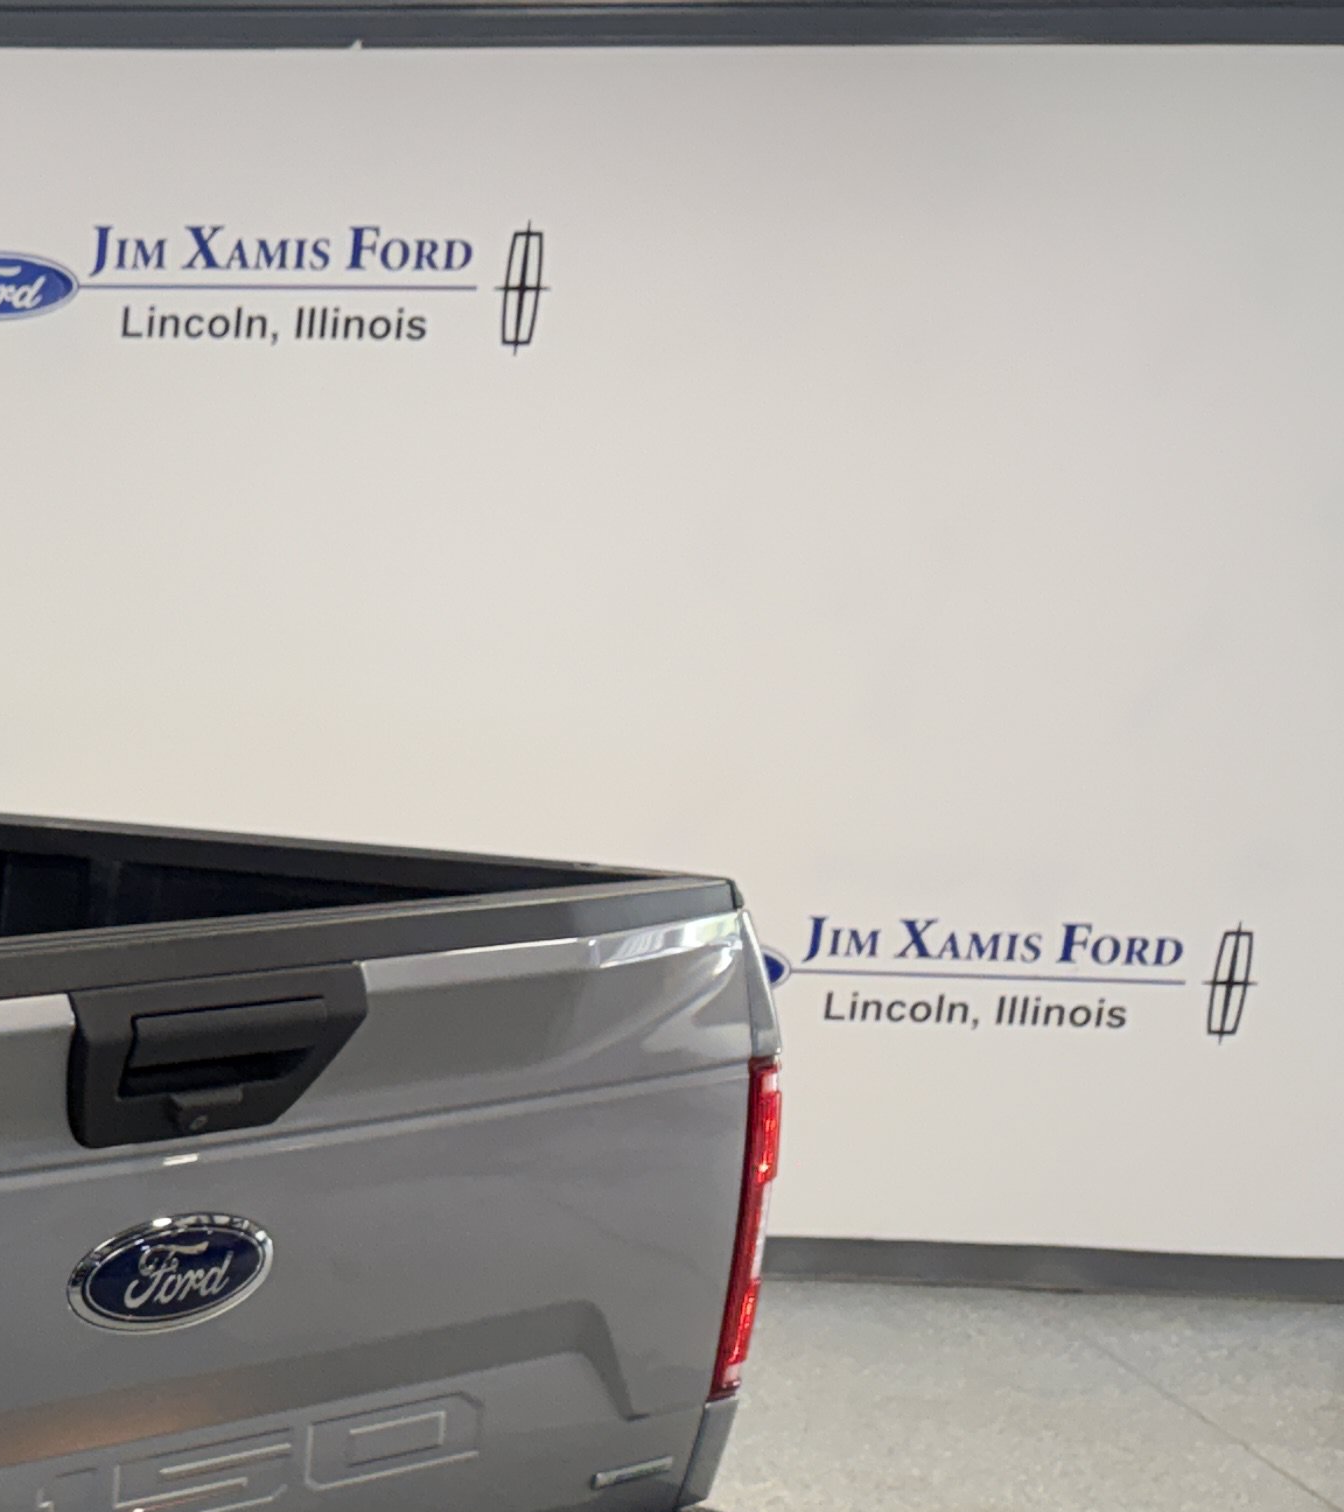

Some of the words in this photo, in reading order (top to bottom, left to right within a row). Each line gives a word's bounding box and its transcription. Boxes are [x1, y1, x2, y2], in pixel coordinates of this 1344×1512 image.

[88, 224, 169, 277] JIM
[181, 225, 331, 273] XAMIS
[345, 226, 474, 273] FORD
[120, 305, 279, 345] Lincoln,
[294, 306, 427, 342] Illinois
[802, 915, 882, 964] JIM
[894, 918, 1042, 964] XAMIS
[1055, 922, 1184, 967] FORD
[823, 991, 980, 1030] Lincoln,
[995, 995, 1127, 1029] Illinois
[124, 1241, 234, 1309] Ford
